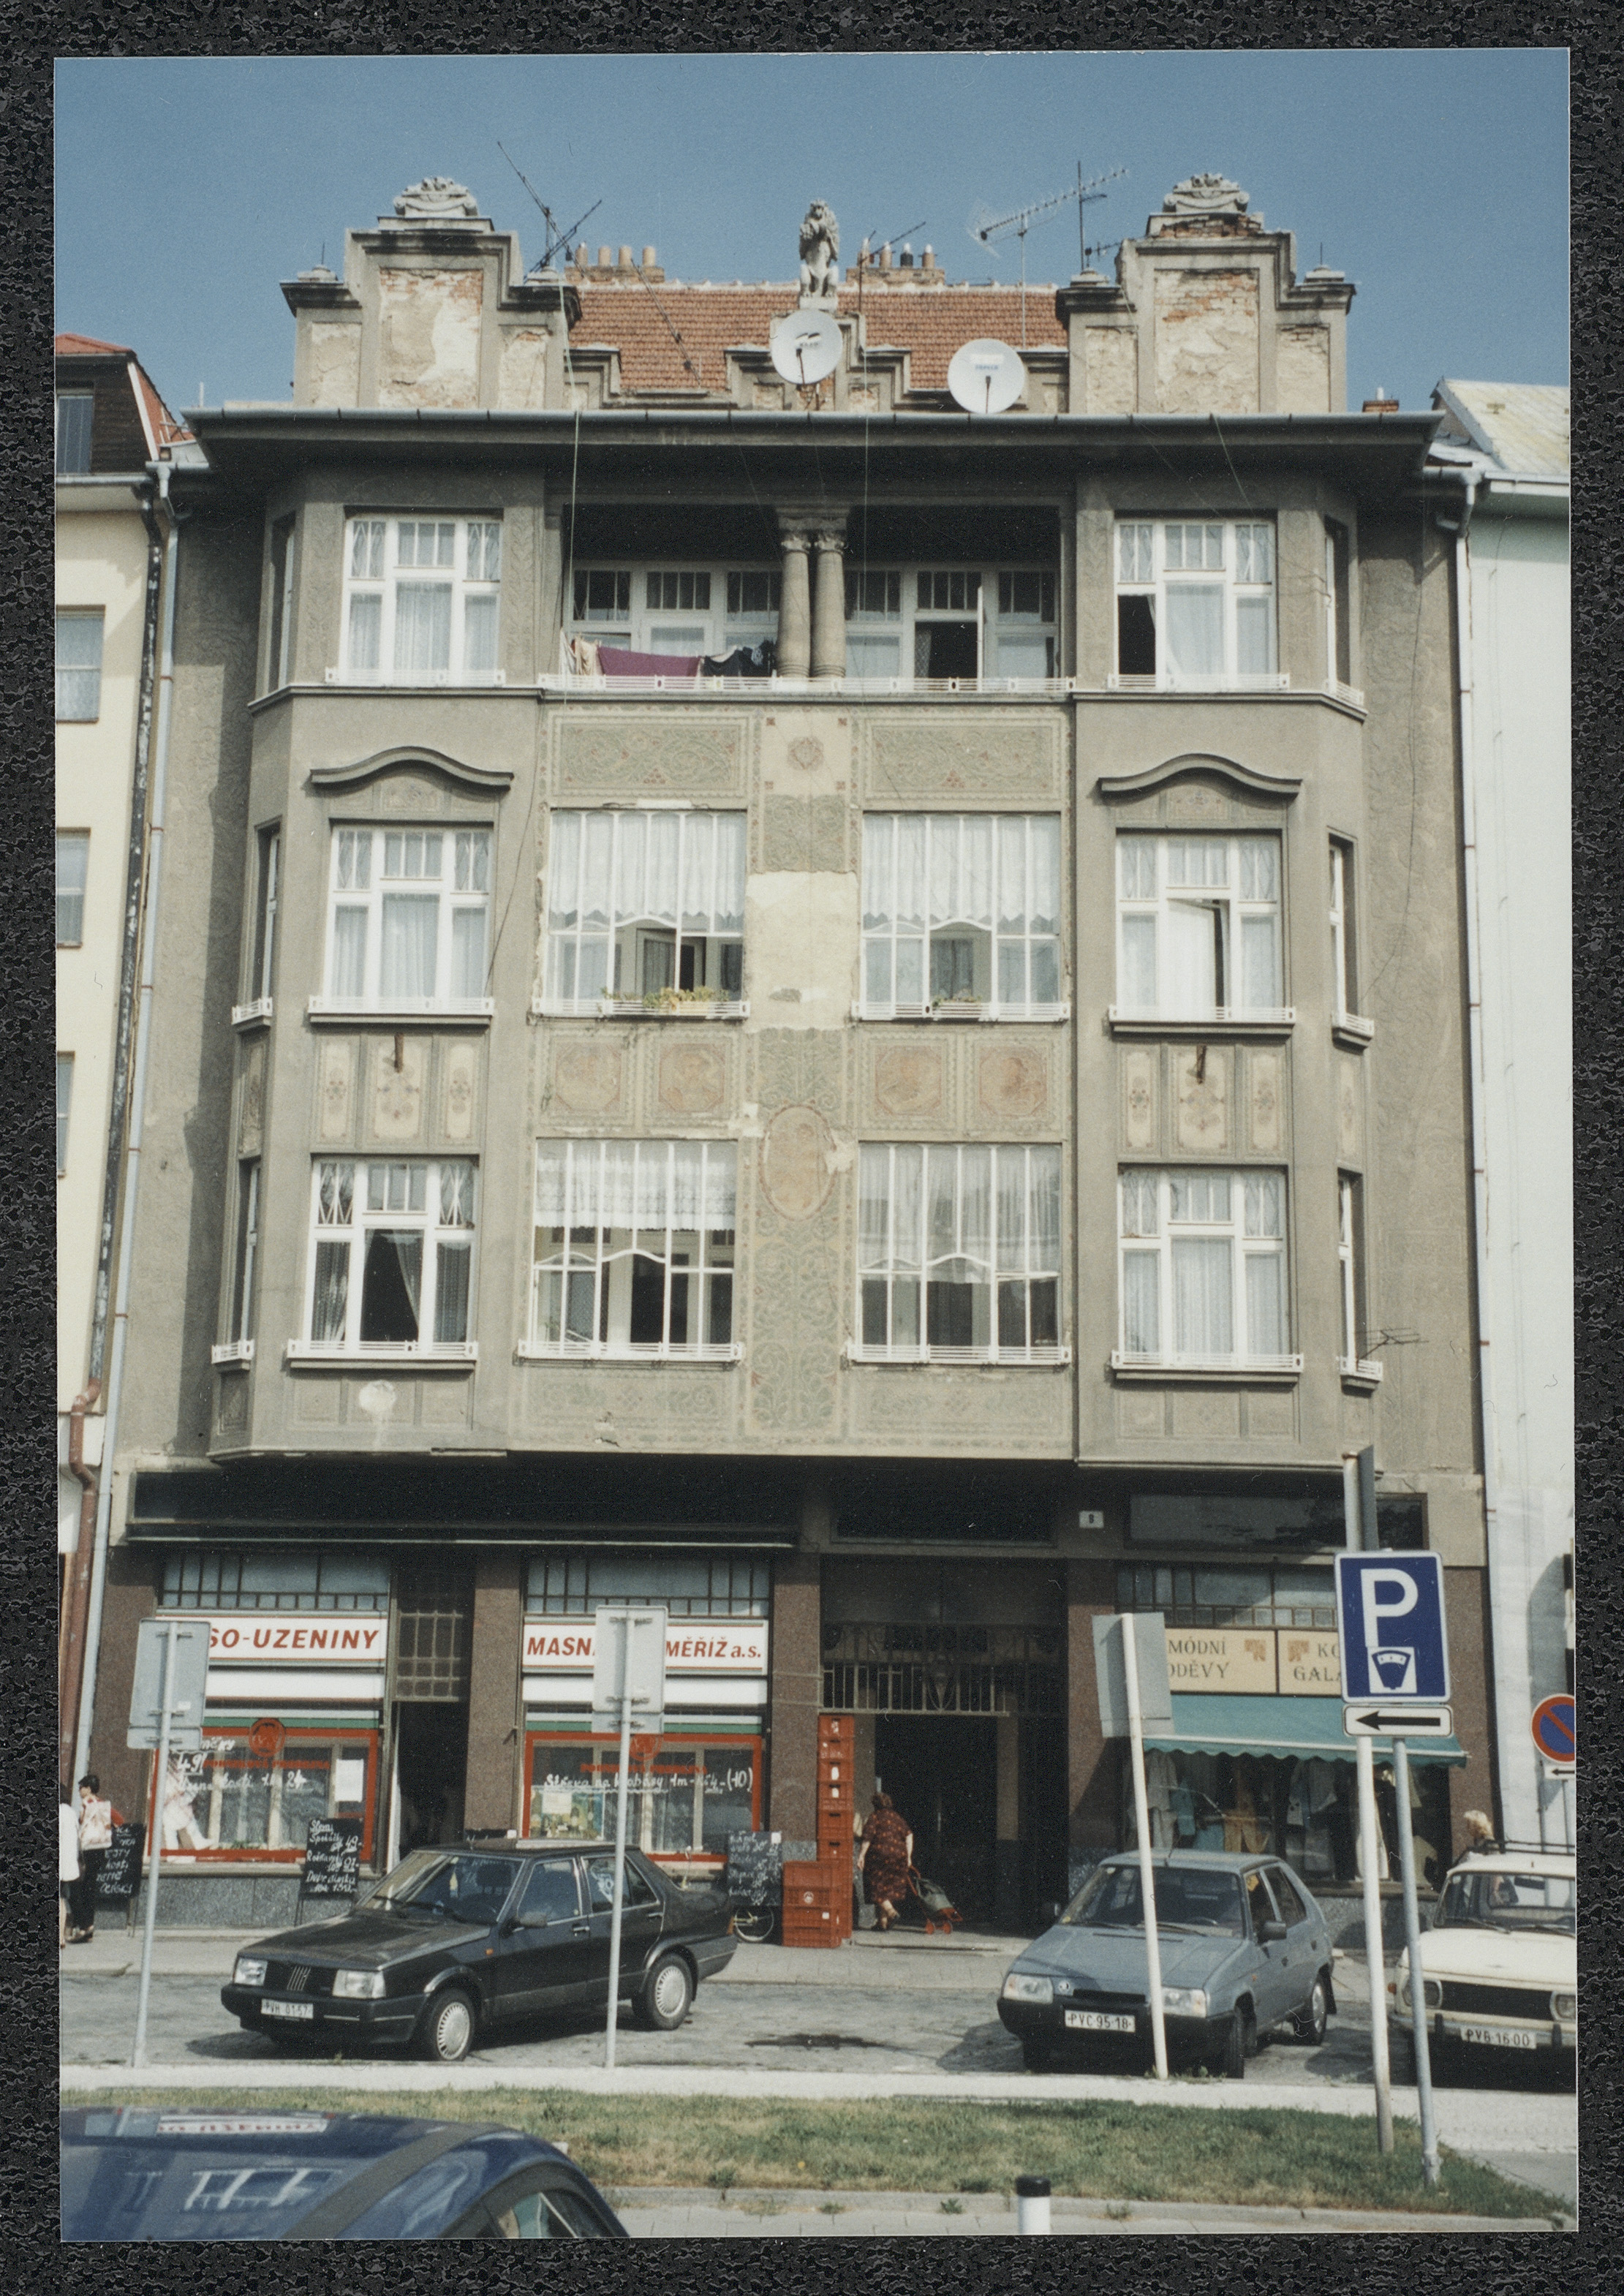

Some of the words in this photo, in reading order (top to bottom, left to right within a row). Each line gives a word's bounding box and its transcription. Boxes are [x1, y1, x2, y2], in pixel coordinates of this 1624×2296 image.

[1360, 1568, 1419, 1647] P
[211, 1628, 379, 1650] SO-UZENINY
[526, 1636, 594, 1656] MASN
[665, 1636, 728, 1658] MĚŘÍŽ
[730, 1644, 762, 1658] a.s.
[1168, 1636, 1227, 1655] MÓDNÍ
